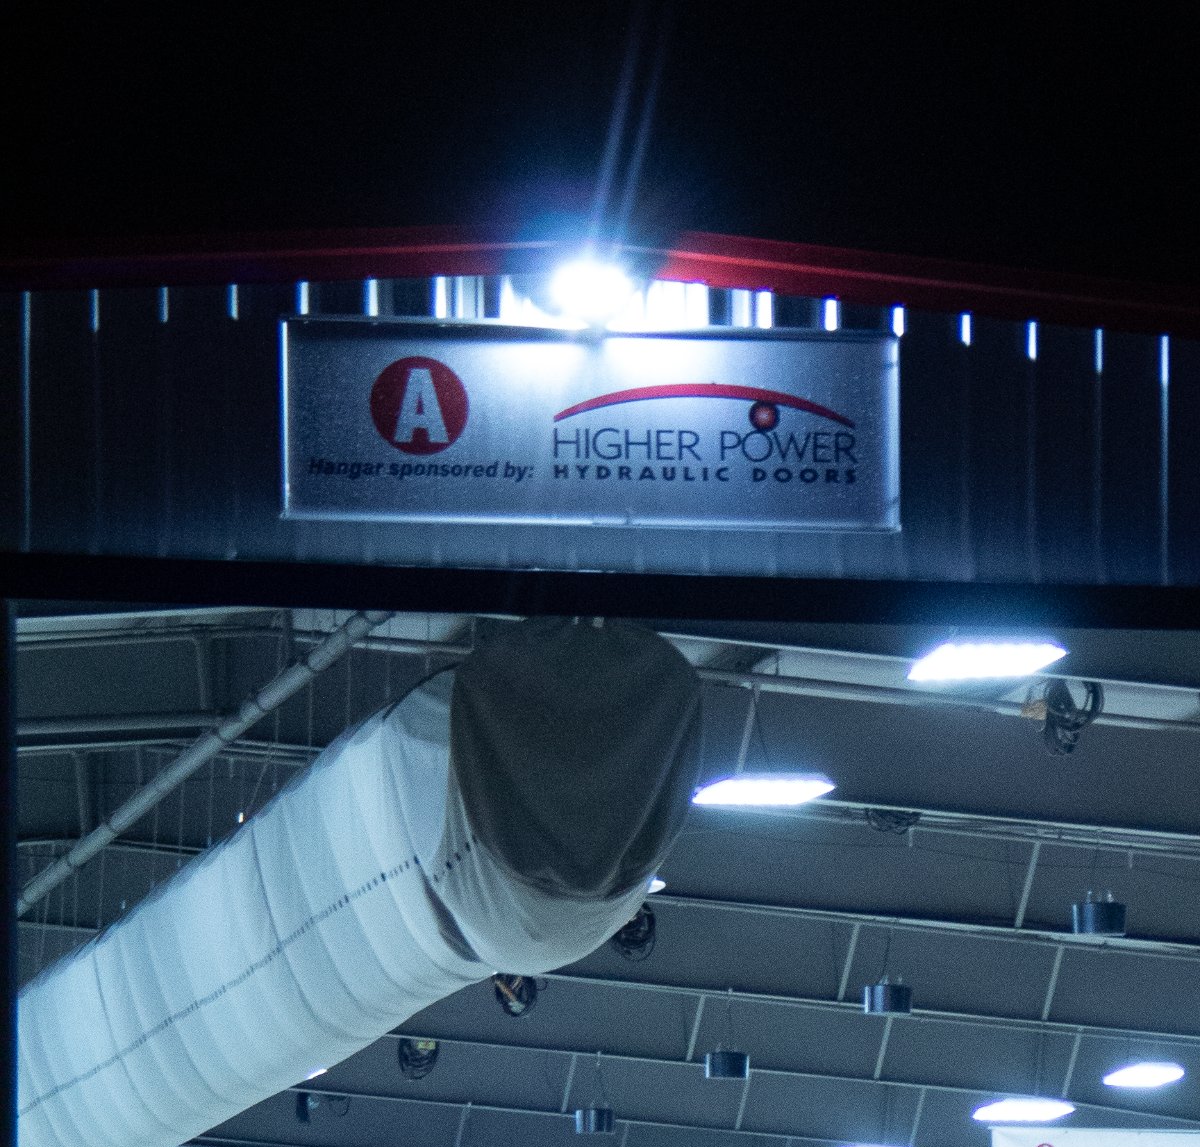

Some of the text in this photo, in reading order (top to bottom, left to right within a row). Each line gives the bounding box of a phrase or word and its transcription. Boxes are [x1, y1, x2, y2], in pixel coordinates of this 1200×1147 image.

[394, 367, 451, 444] A
[552, 427, 858, 463] HIGHER POWER
[308, 458, 534, 482] Hangar sponsored by:
[553, 464, 857, 484] HYDRAULIC DOORS
